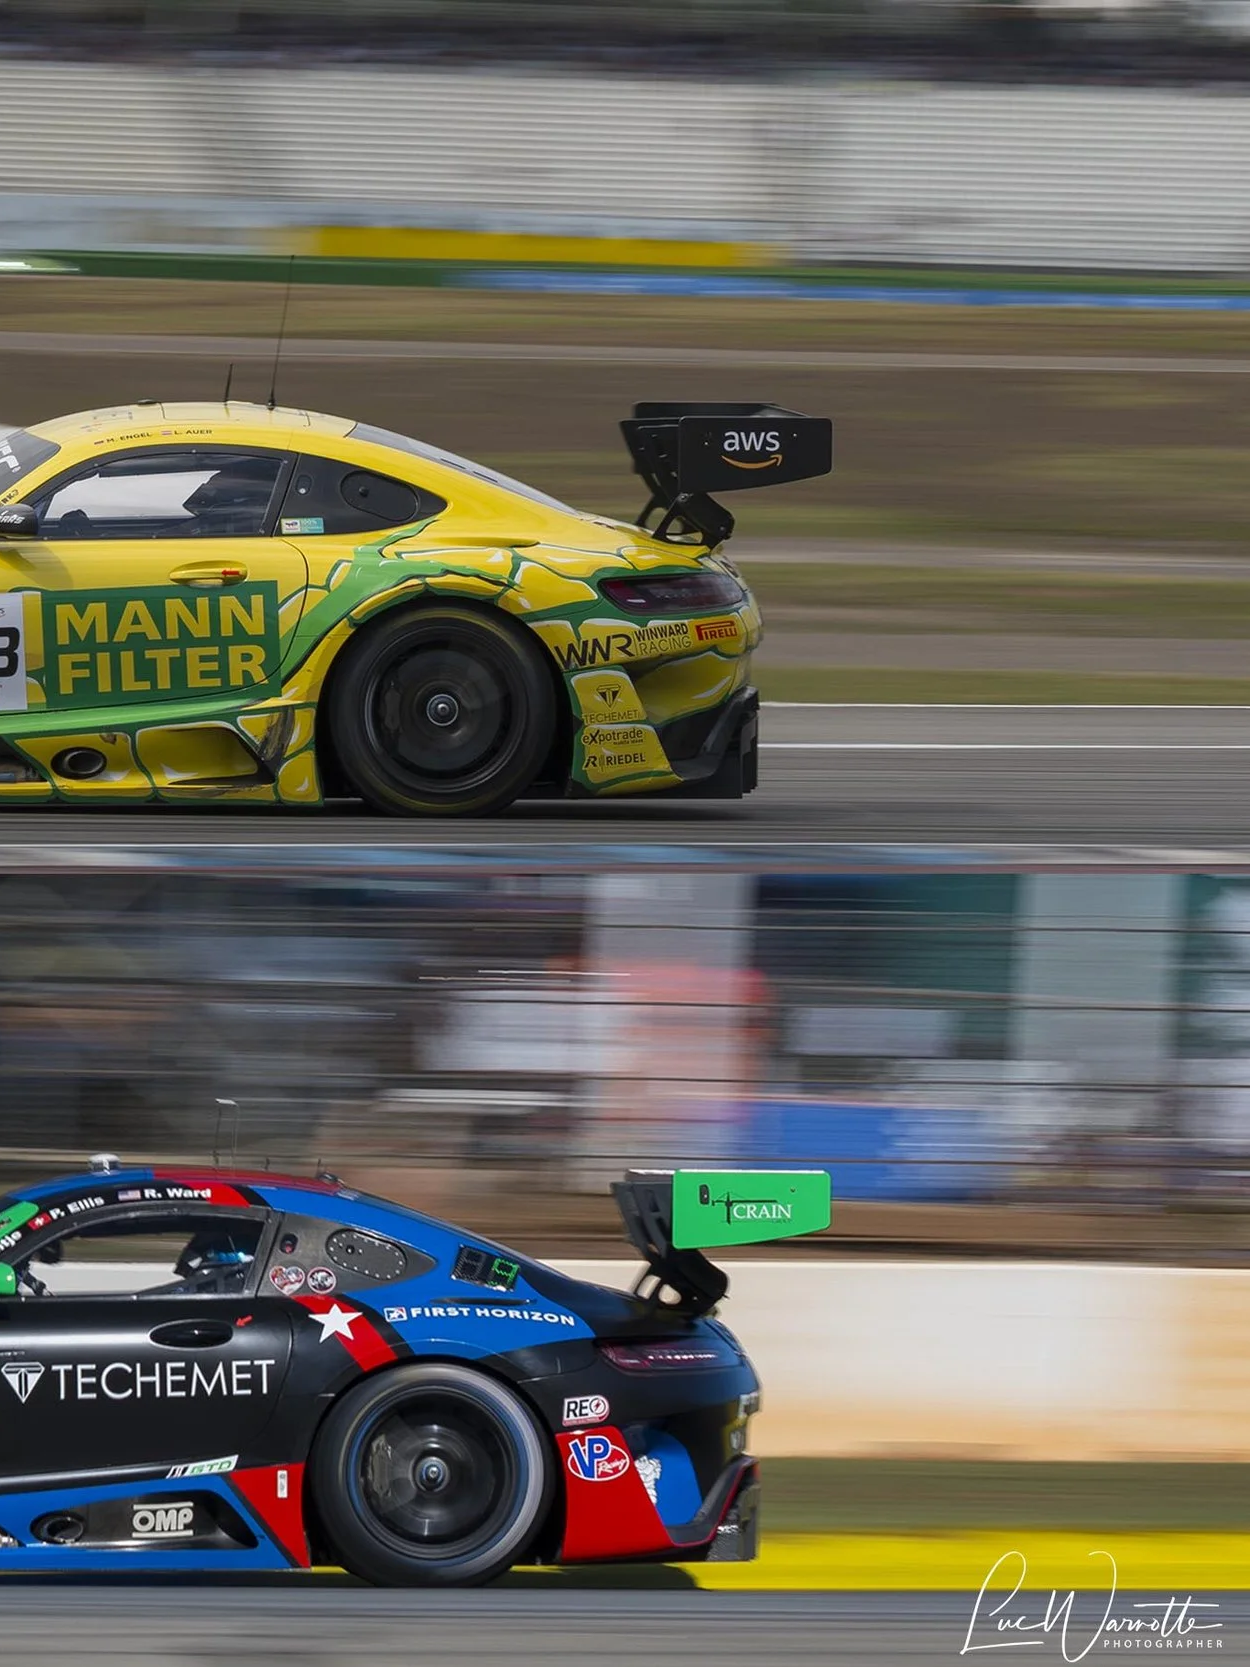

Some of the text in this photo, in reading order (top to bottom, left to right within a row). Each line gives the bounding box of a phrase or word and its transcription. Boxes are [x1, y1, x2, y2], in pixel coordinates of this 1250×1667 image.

[120, 432, 152, 441] ENGEL
[723, 430, 780, 452] aws
[55, 594, 265, 645] MANN
[634, 622, 689, 642] WINWARD
[696, 620, 738, 641] PIRELLI
[638, 636, 692, 656] RACING
[57, 644, 269, 695] FILTER
[582, 709, 639, 725] TECHEMET
[605, 753, 646, 766] RIEDEL
[144, 1187, 212, 1199] R. Ward
[49, 1196, 105, 1220] P. Ellis
[732, 1204, 793, 1219] CRAIN
[410, 1306, 576, 1326] FIRST HORIZON
[51, 1359, 276, 1400] TECHEMET
[189, 1460, 232, 1475] GTD
[568, 1435, 612, 1480] VP
[132, 1506, 194, 1533] OMP
